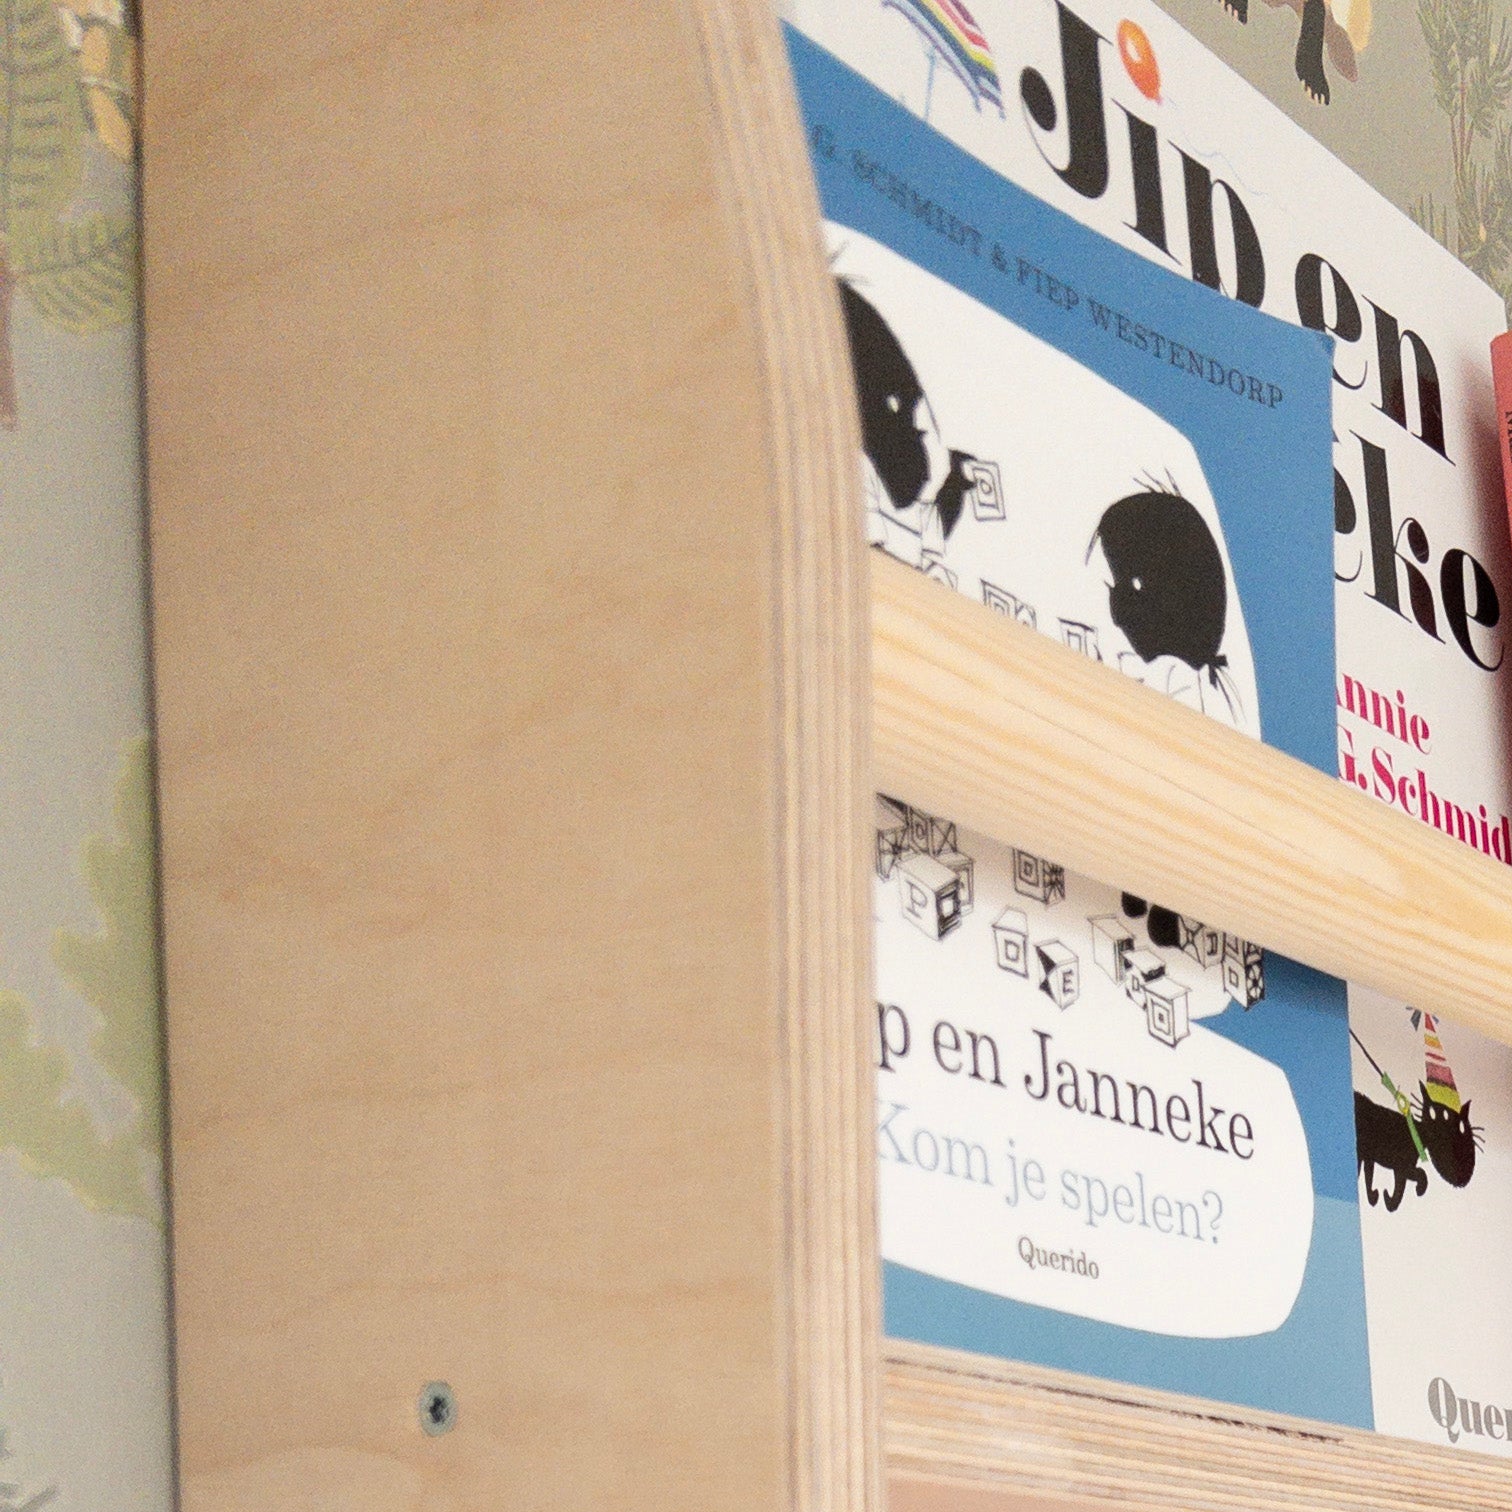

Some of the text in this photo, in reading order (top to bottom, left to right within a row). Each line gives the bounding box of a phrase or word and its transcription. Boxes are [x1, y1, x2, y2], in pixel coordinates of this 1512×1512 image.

[849, 147, 985, 256] SCHMIDT
[989, 243, 1010, 274] &
[1015, 256, 1081, 313] FIEP
[1087, 299, 1285, 411] WESTENDORP
[1020, 0, 1456, 466] Jip en
[1335, 673, 1432, 755] nnie
[933, 1021, 1007, 1088] en
[1024, 1028, 1255, 1160] Janneke
[877, 1101, 1223, 1245] Kom je spelen?
[1017, 1236, 1100, 1280] Querido
